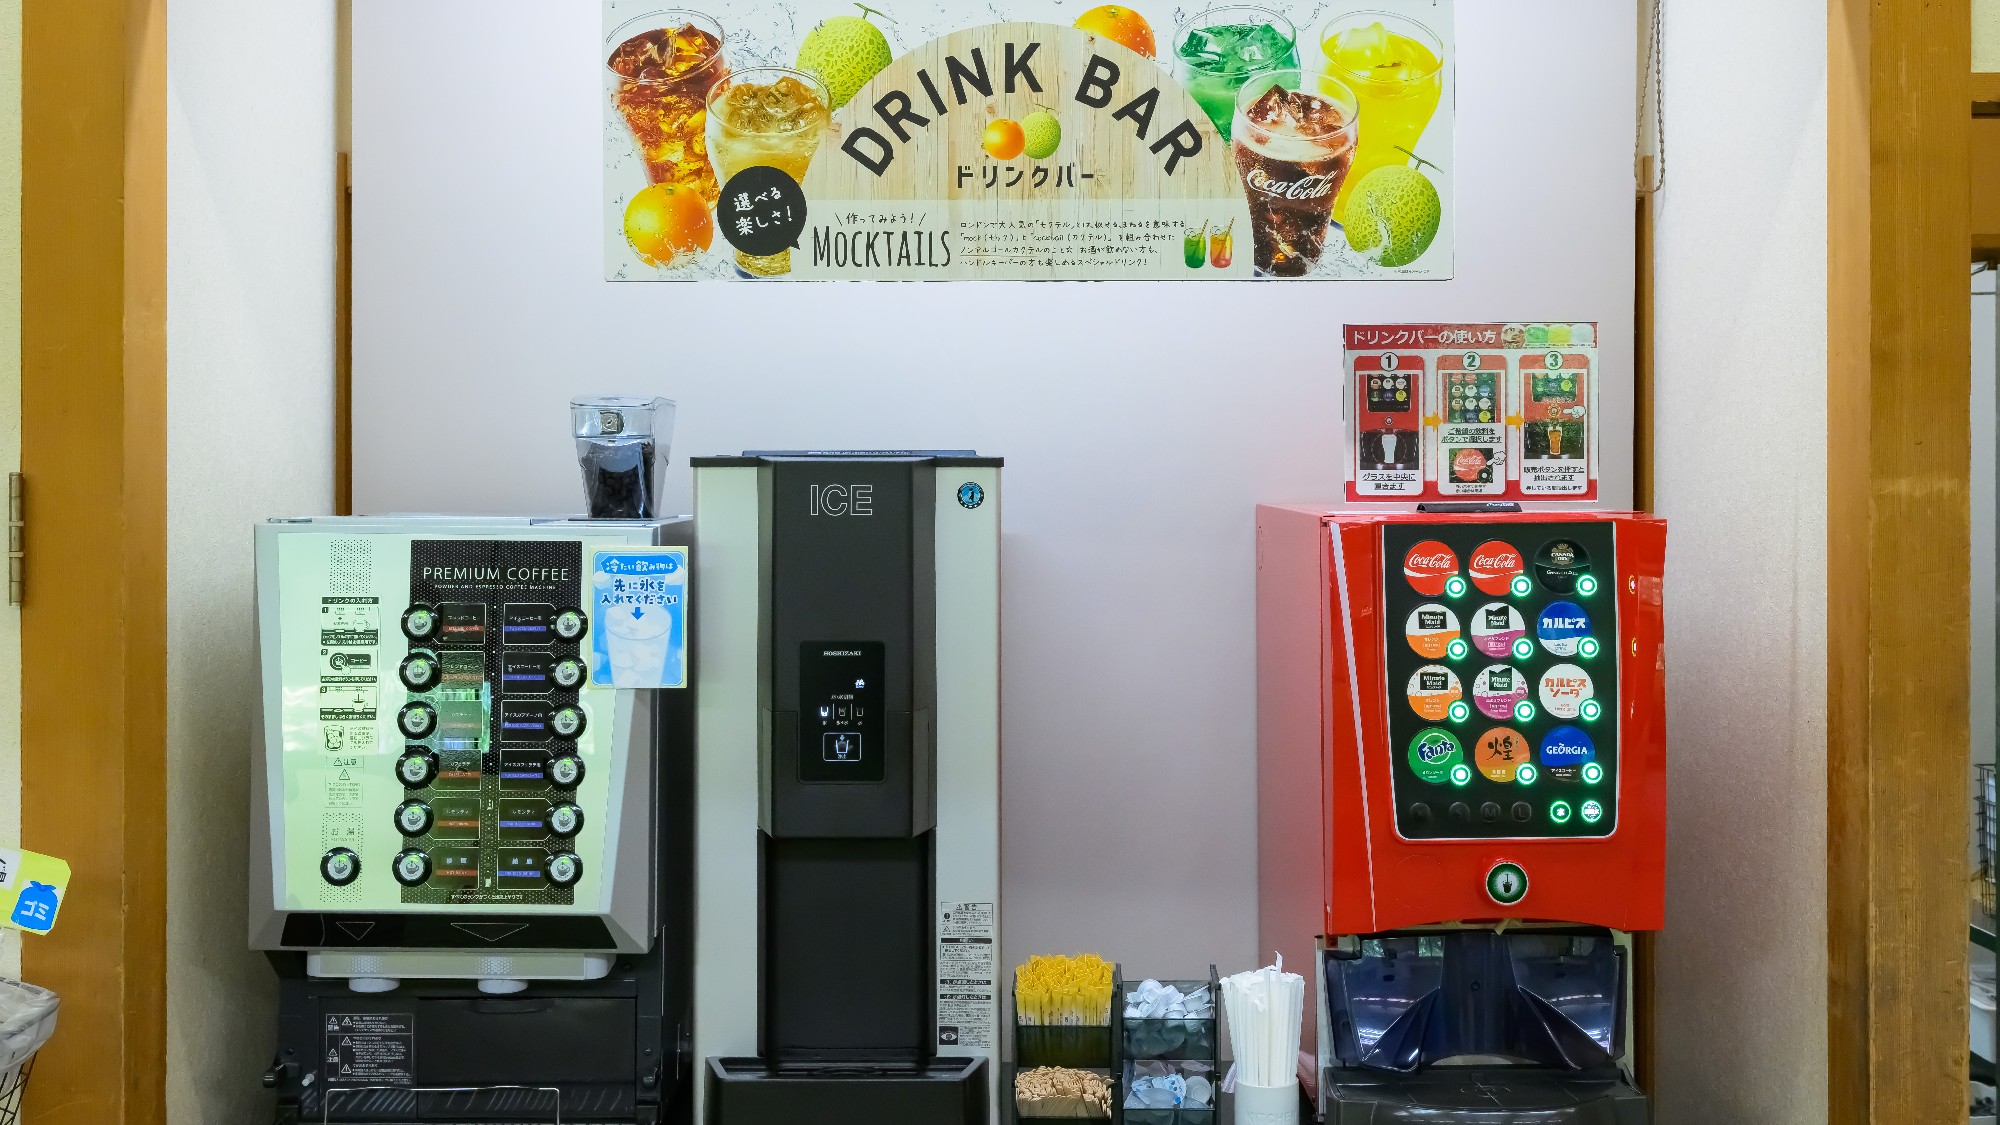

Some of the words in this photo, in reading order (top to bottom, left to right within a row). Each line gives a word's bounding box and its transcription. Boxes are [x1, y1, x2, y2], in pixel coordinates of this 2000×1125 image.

[841, 42, 1044, 178] DRINK
[1075, 53, 1203, 176] BAR
[957, 163, 1095, 189] ドリンクバー
[733, 187, 781, 212] 選べる
[1353, 328, 1497, 345] ドリンクバーの使い方
[1362, 472, 1417, 481] グラスを中央に
[810, 484, 873, 516] ICE
[605, 558, 674, 573] 冷たい飲み物は
[1409, 553, 1453, 569] Coca-Cola
[1474, 553, 1518, 569] Coca-Cola
[423, 567, 500, 580] PREMIUM
[507, 567, 569, 581] COFFEE
[613, 578, 665, 593] 先に氷を
[601, 593, 677, 605] 入れてください
[1542, 617, 1587, 629] カルピス
[1545, 677, 1587, 688] カルピス
[1550, 687, 1583, 699] ソーダ
[1417, 740, 1456, 762] Fanta
[1545, 743, 1588, 755] GEORGIA
[20, 900, 50, 921] ゴミ
